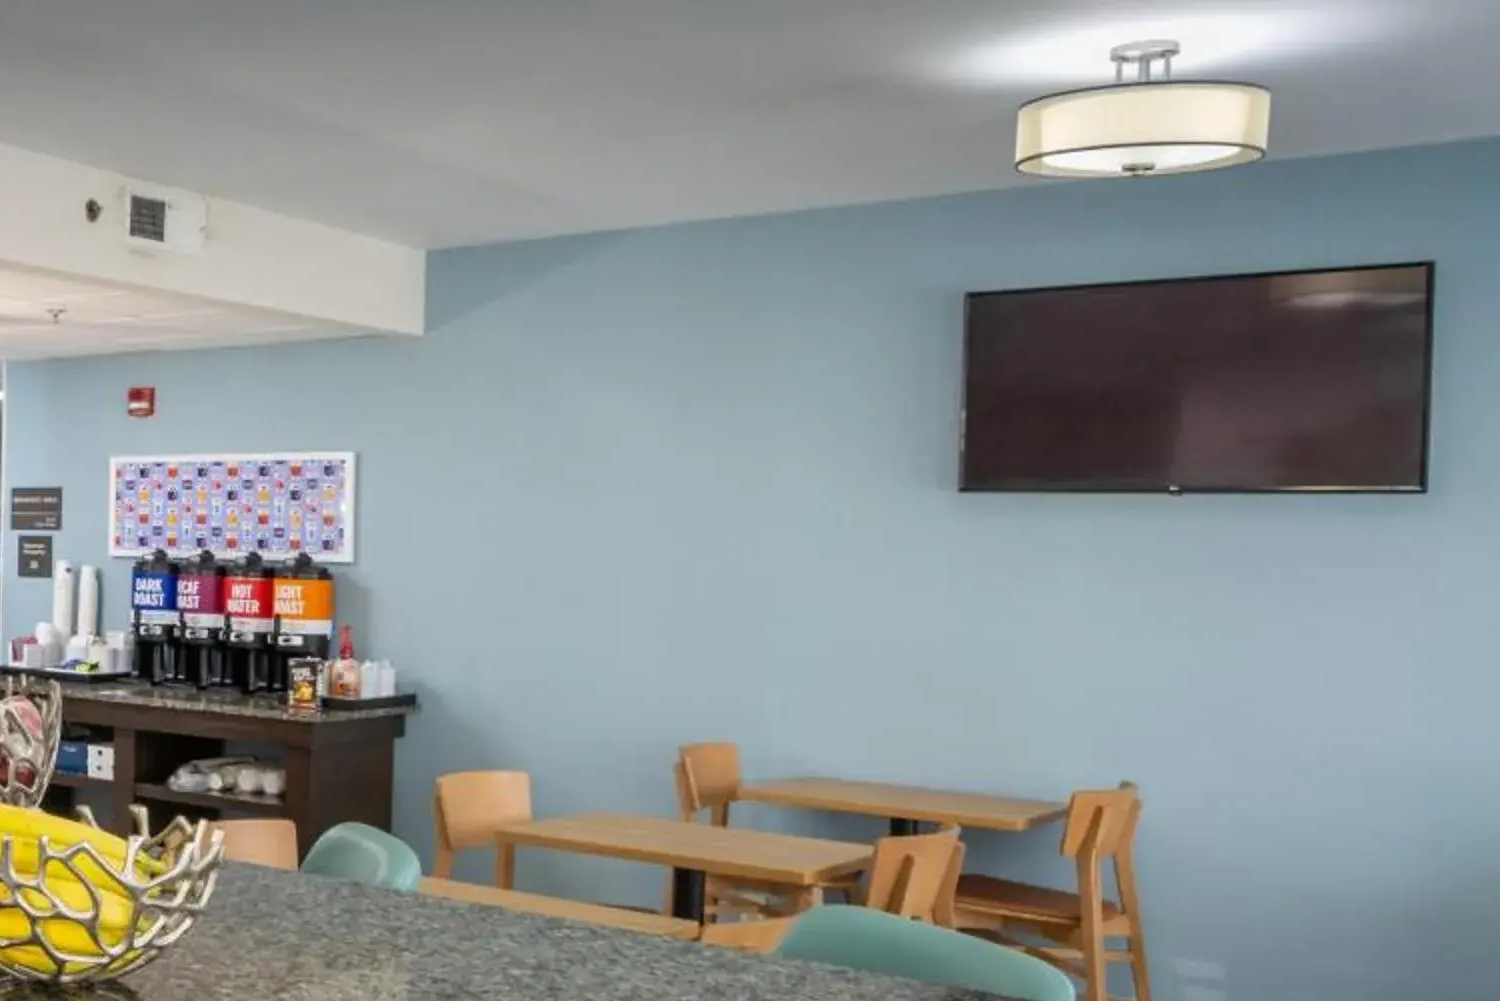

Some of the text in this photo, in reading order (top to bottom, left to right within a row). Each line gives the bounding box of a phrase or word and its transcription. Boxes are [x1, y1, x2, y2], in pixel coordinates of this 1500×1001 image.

[135, 577, 163, 591] DARK
[231, 584, 253, 599] HOT
[227, 599, 261, 614] WATER
